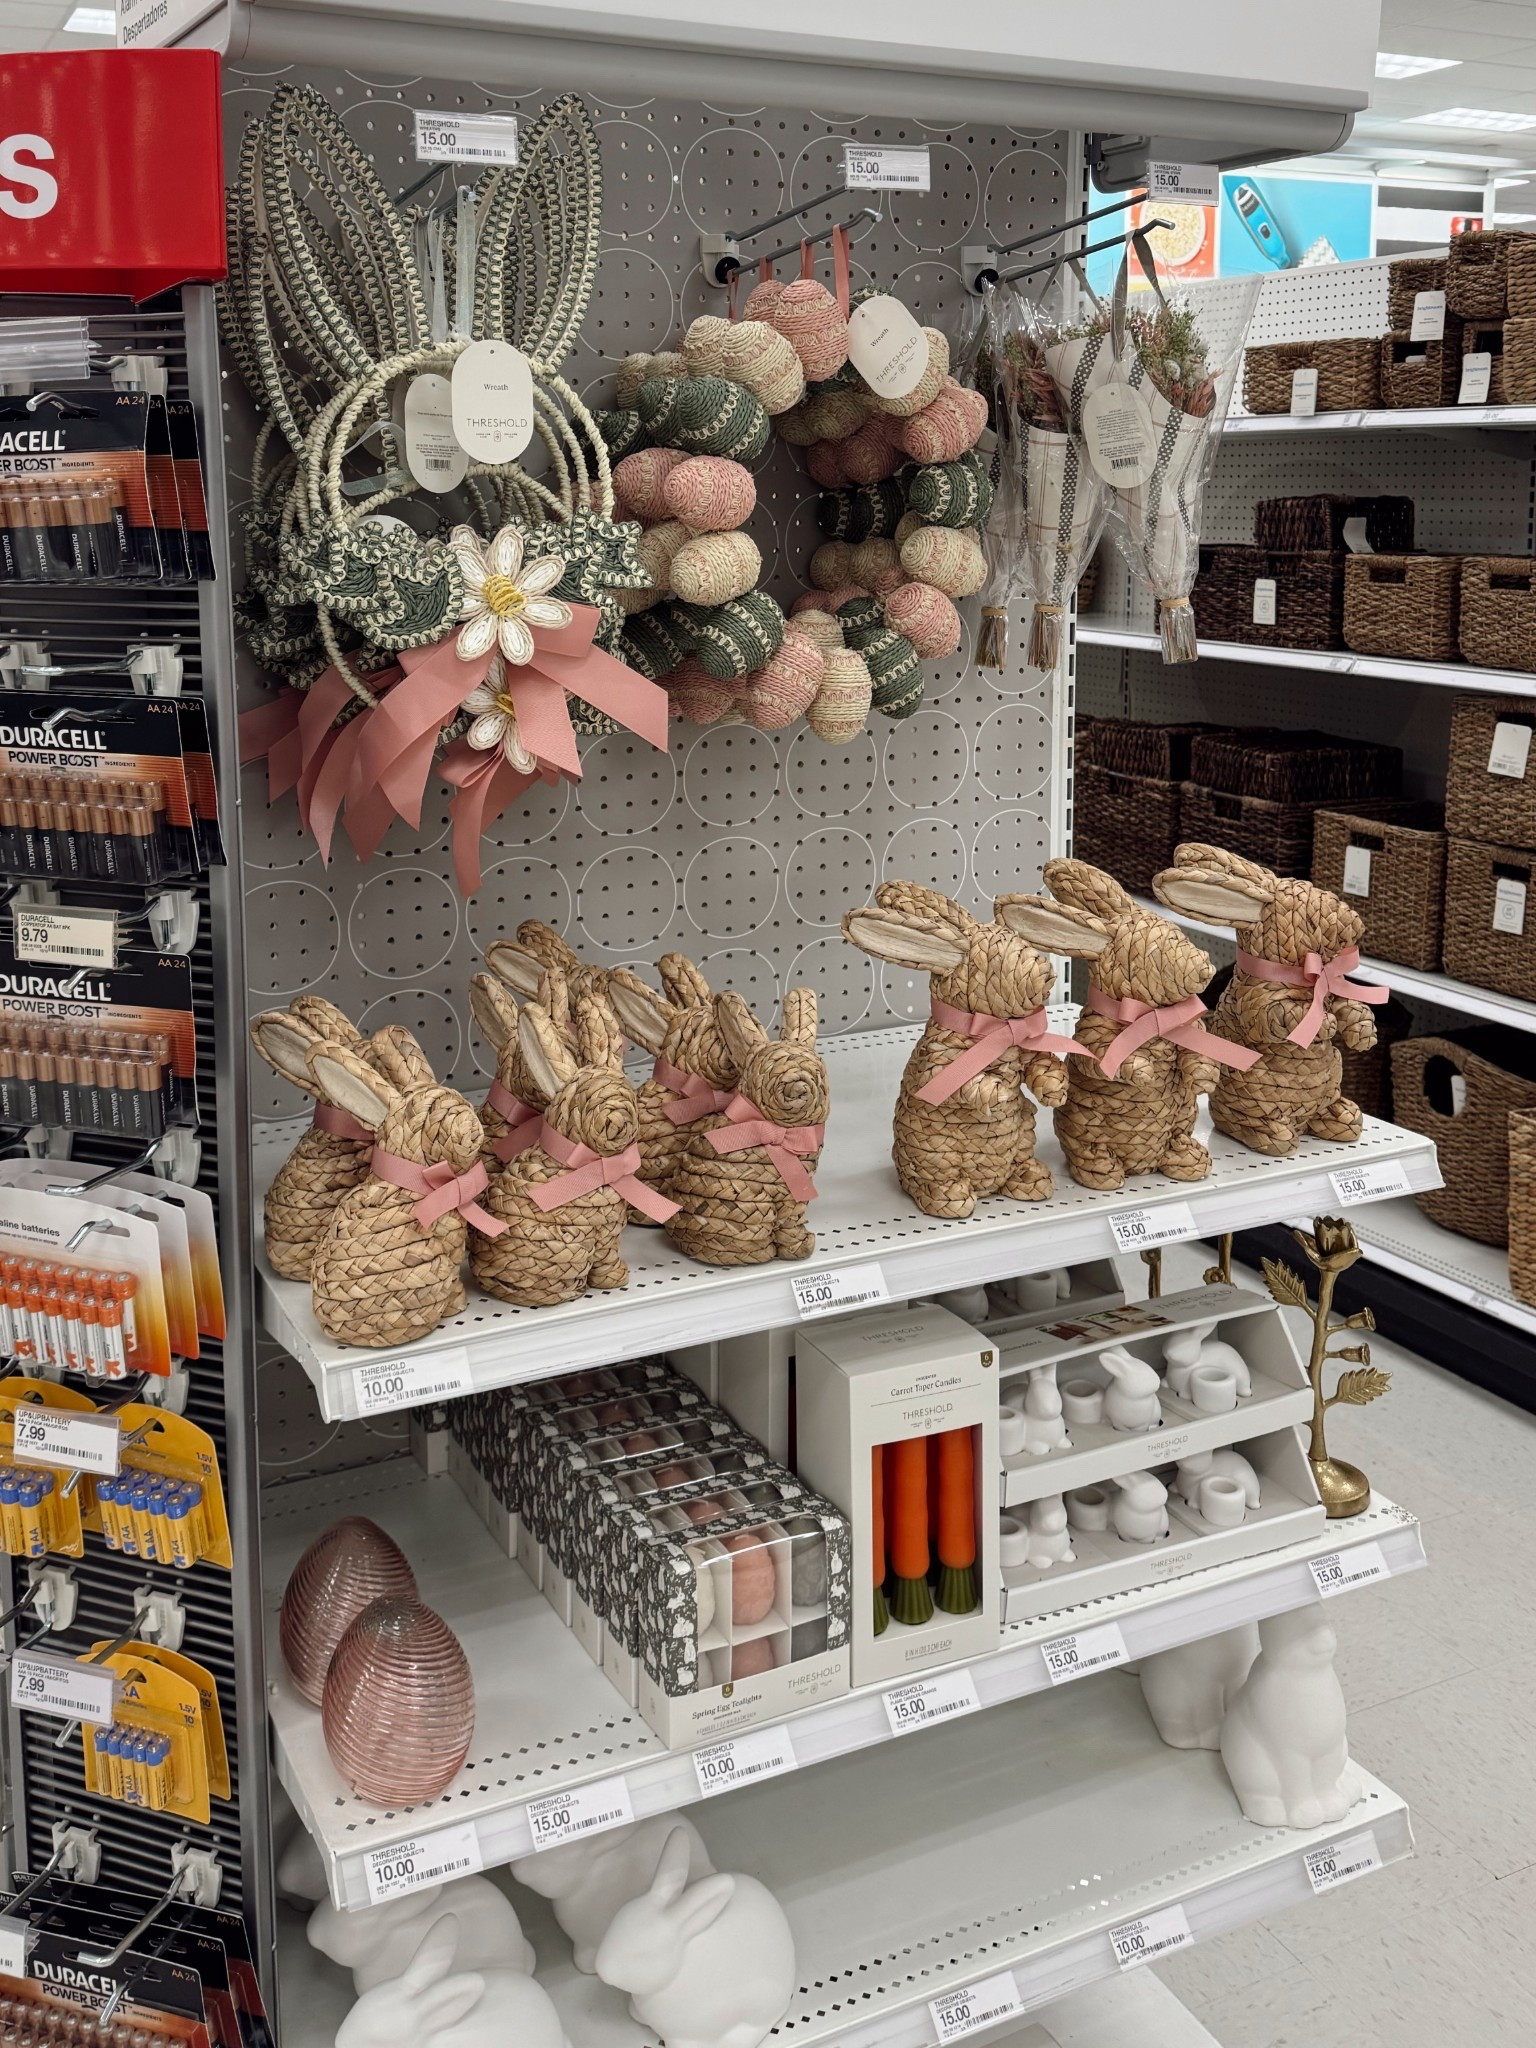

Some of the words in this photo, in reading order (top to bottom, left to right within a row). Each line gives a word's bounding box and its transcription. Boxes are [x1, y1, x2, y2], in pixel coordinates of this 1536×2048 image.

[123, 0, 168, 45] Despertadores
[419, 118, 460, 128] THRESHOLD
[420, 132, 456, 146] 15.00
[849, 150, 883, 158] THRESHOLD
[0, 133, 58, 219] S
[850, 162, 879, 174] 15.00
[1155, 174, 1179, 186] 15.00
[870, 328, 890, 347] Wreath
[876, 336, 918, 384] THRESHOLD
[484, 383, 509, 391] Wreath
[115, 396, 130, 405] AA
[131, 395, 145, 405] 24
[178, 405, 190, 414] 24
[466, 418, 528, 428] THRESHOLD
[14, 458, 56, 472] BOOST
[116, 514, 127, 552] DURACELL
[2, 535, 13, 572] DURACELL
[36, 534, 47, 572] DURACELL
[72, 533, 82, 571] DURACELL
[147, 704, 160, 713] AA
[161, 705, 173, 714] 24
[189, 702, 200, 711] 24
[1, 726, 107, 750] DURACELL
[8, 751, 56, 765] POWER
[60, 754, 100, 767] BOOST
[25, 834, 36, 868] DURACELL
[21, 914, 54, 923] DURACELL
[21, 927, 48, 943] 9.79
[158, 958, 172, 967] AA
[174, 959, 186, 968] 24
[0, 974, 111, 1001] DURACELL
[3, 999, 55, 1014] POWER
[59, 1003, 103, 1018] BOOST
[1333, 1168, 1364, 1179] THRESHOLD
[1339, 1179, 1366, 1194] 15.00
[1111, 1211, 1144, 1222] THRESHOLD
[21, 1223, 60, 1237] batteries
[1117, 1223, 1146, 1239] 15.00
[794, 1273, 832, 1287] THRESHOLD
[798, 1286, 832, 1305] 15.00
[1155, 1289, 1232, 1310] THRESHOLD
[861, 1325, 924, 1342] THRESHOLD
[985, 1353, 990, 1361] 6
[361, 1361, 406, 1377] THRESHOLD
[363, 1377, 404, 1398] 10.00
[890, 1386, 914, 1397] Carrot
[914, 1382, 934, 1394] Taper
[935, 1376, 962, 1388] Candles
[18, 1411, 71, 1426] UP&UPBATTERY
[902, 1403, 954, 1421] THRESHOLD
[18, 1424, 46, 1441] 7.99
[1148, 1435, 1189, 1452] THRESHOLD
[31, 1527, 39, 1542] AA
[123, 1526, 130, 1540] AA
[171, 1540, 178, 1554] AA
[1150, 1552, 1193, 1570] THRESHOLD
[1310, 1554, 1340, 1568] THRESHOLD
[1316, 1566, 1343, 1584] 15.00
[940, 1640, 952, 1649] EACH
[1043, 1637, 1076, 1652] THRESHOLD
[1048, 1649, 1079, 1669] 15.00
[17, 1662, 70, 1679] UP&UPBATTERY
[787, 1663, 842, 1689] THRESHOLD
[18, 1675, 45, 1692] 7.99
[888, 1684, 924, 1700] THRESHOLD
[178, 1703, 196, 1714] 1.5V
[692, 1707, 716, 1719] Spring
[717, 1703, 731, 1713] Egg
[731, 1694, 762, 1708] Tealights
[894, 1698, 925, 1719] 15.00
[184, 1715, 194, 1724] 10
[696, 1743, 735, 1760] THRESHOLD
[700, 1757, 735, 1779] 10.00
[529, 1794, 571, 1812] THRESHOLD
[530, 1806, 559, 1818] DECORATIVE
[534, 1809, 570, 1833] 15.00
[371, 1842, 416, 1861] THRESHOLD
[1306, 1846, 1335, 1862] THRESHOLD
[372, 1856, 402, 1868] DECORATIVE
[375, 1858, 414, 1883] 10.00
[1311, 1859, 1336, 1878] 15.00
[1111, 1921, 1142, 1938] THRESHOLD
[198, 1939, 209, 1948] AA
[210, 1942, 221, 1951] 24
[1116, 1935, 1145, 1956] 10.00
[172, 1969, 183, 1978] AA
[185, 1972, 196, 1981] 24
[43, 1984, 88, 2004] POWER
[934, 1990, 968, 2008] THRESHOLD
[940, 2004, 970, 2027] 15.00
